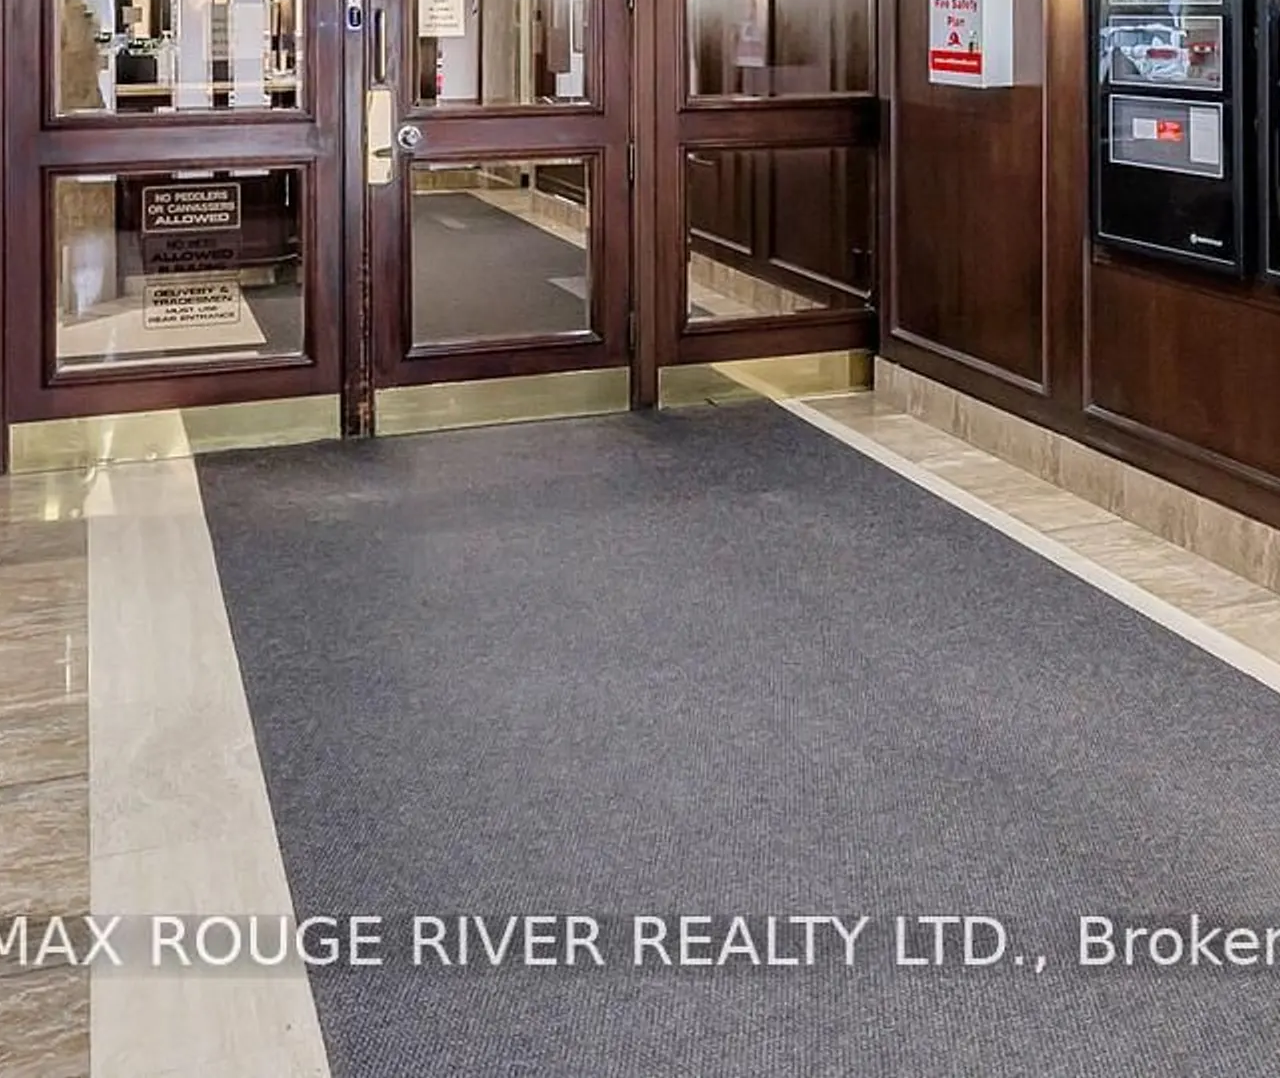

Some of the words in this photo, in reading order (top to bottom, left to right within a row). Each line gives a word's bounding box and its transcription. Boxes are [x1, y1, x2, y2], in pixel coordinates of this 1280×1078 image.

[155, 193, 172, 203] NO
[148, 205, 164, 215] OR
[154, 213, 230, 226] ALLOWED
[151, 249, 234, 263] ALLOWED
[153, 287, 213, 298] DELIVERY
